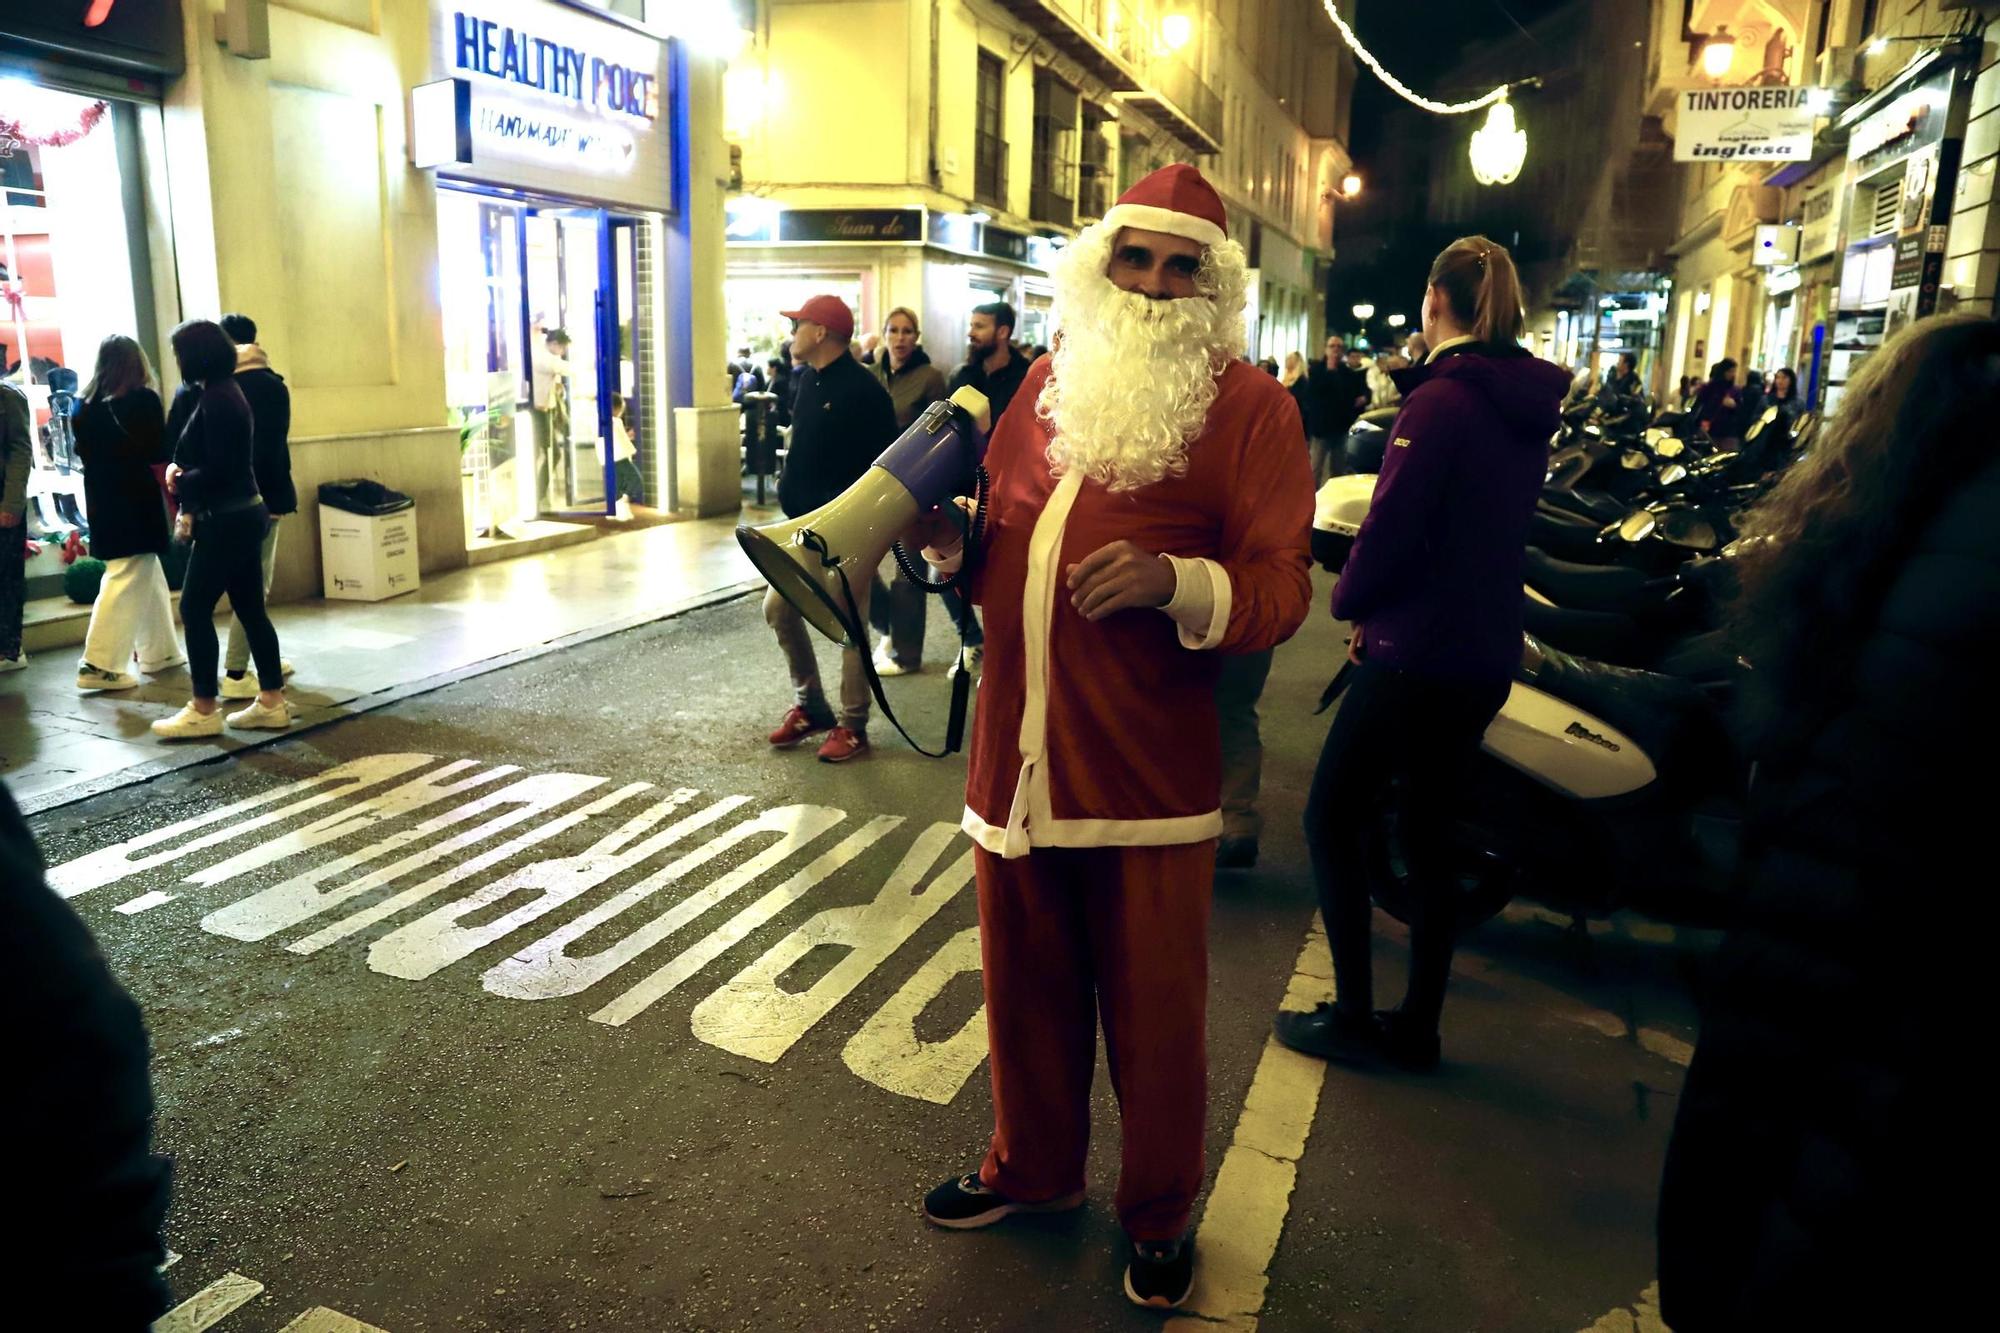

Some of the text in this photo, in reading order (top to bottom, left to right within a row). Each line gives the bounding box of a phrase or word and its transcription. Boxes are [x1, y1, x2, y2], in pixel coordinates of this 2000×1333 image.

[454, 12, 656, 120] HEALTHY POKE
[1687, 89, 1808, 111] TINTORERIA
[1692, 143, 1792, 158] inglesa
